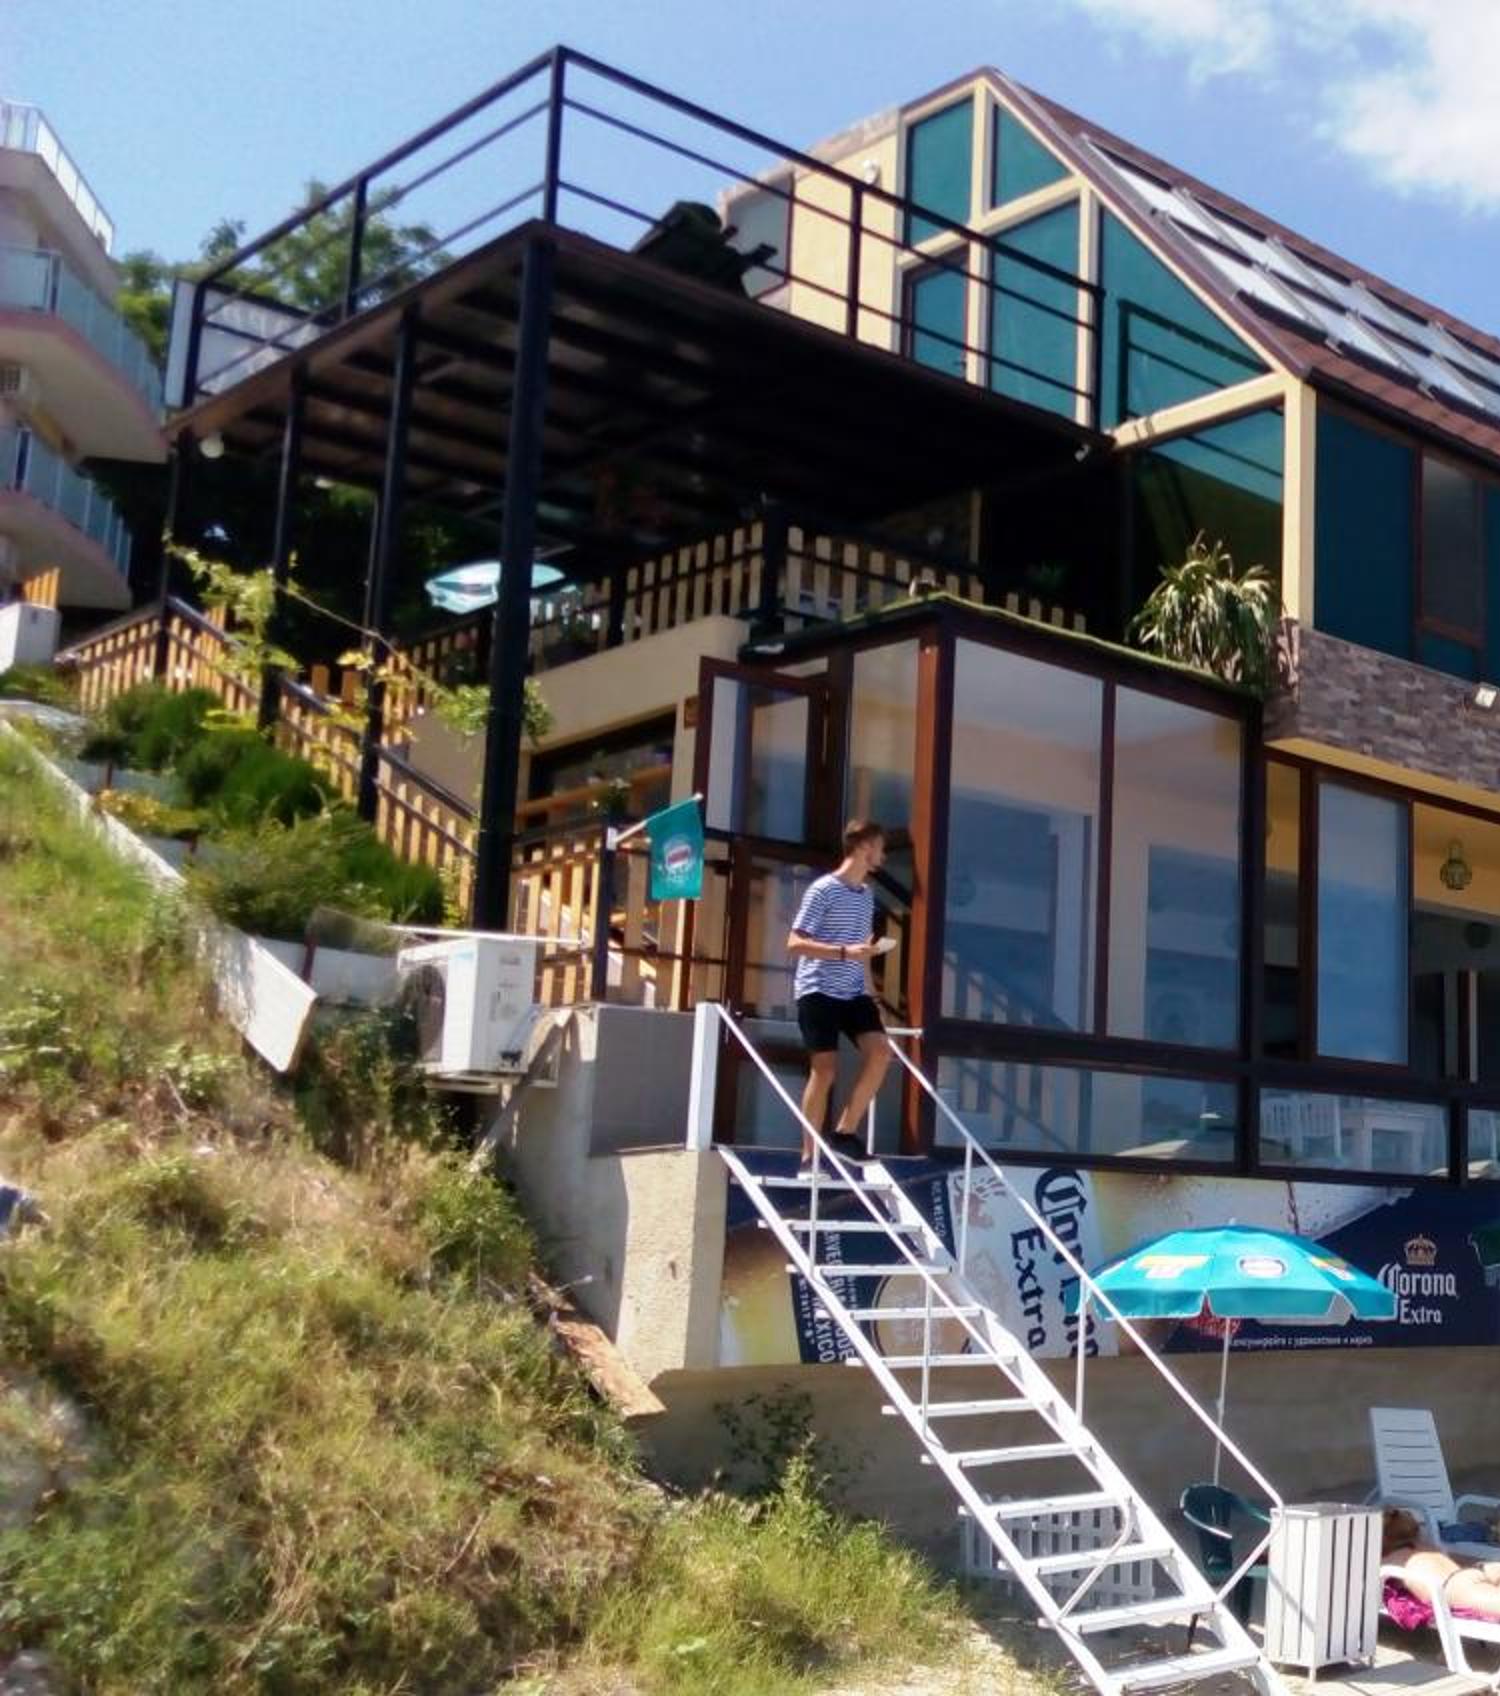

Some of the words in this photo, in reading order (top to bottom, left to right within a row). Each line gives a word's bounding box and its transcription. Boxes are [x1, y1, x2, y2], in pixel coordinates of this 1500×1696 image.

[1010, 1225, 1048, 1350] Extra
[1377, 1262, 1459, 1299] Corona
[1399, 1299, 1442, 1324] Extra
